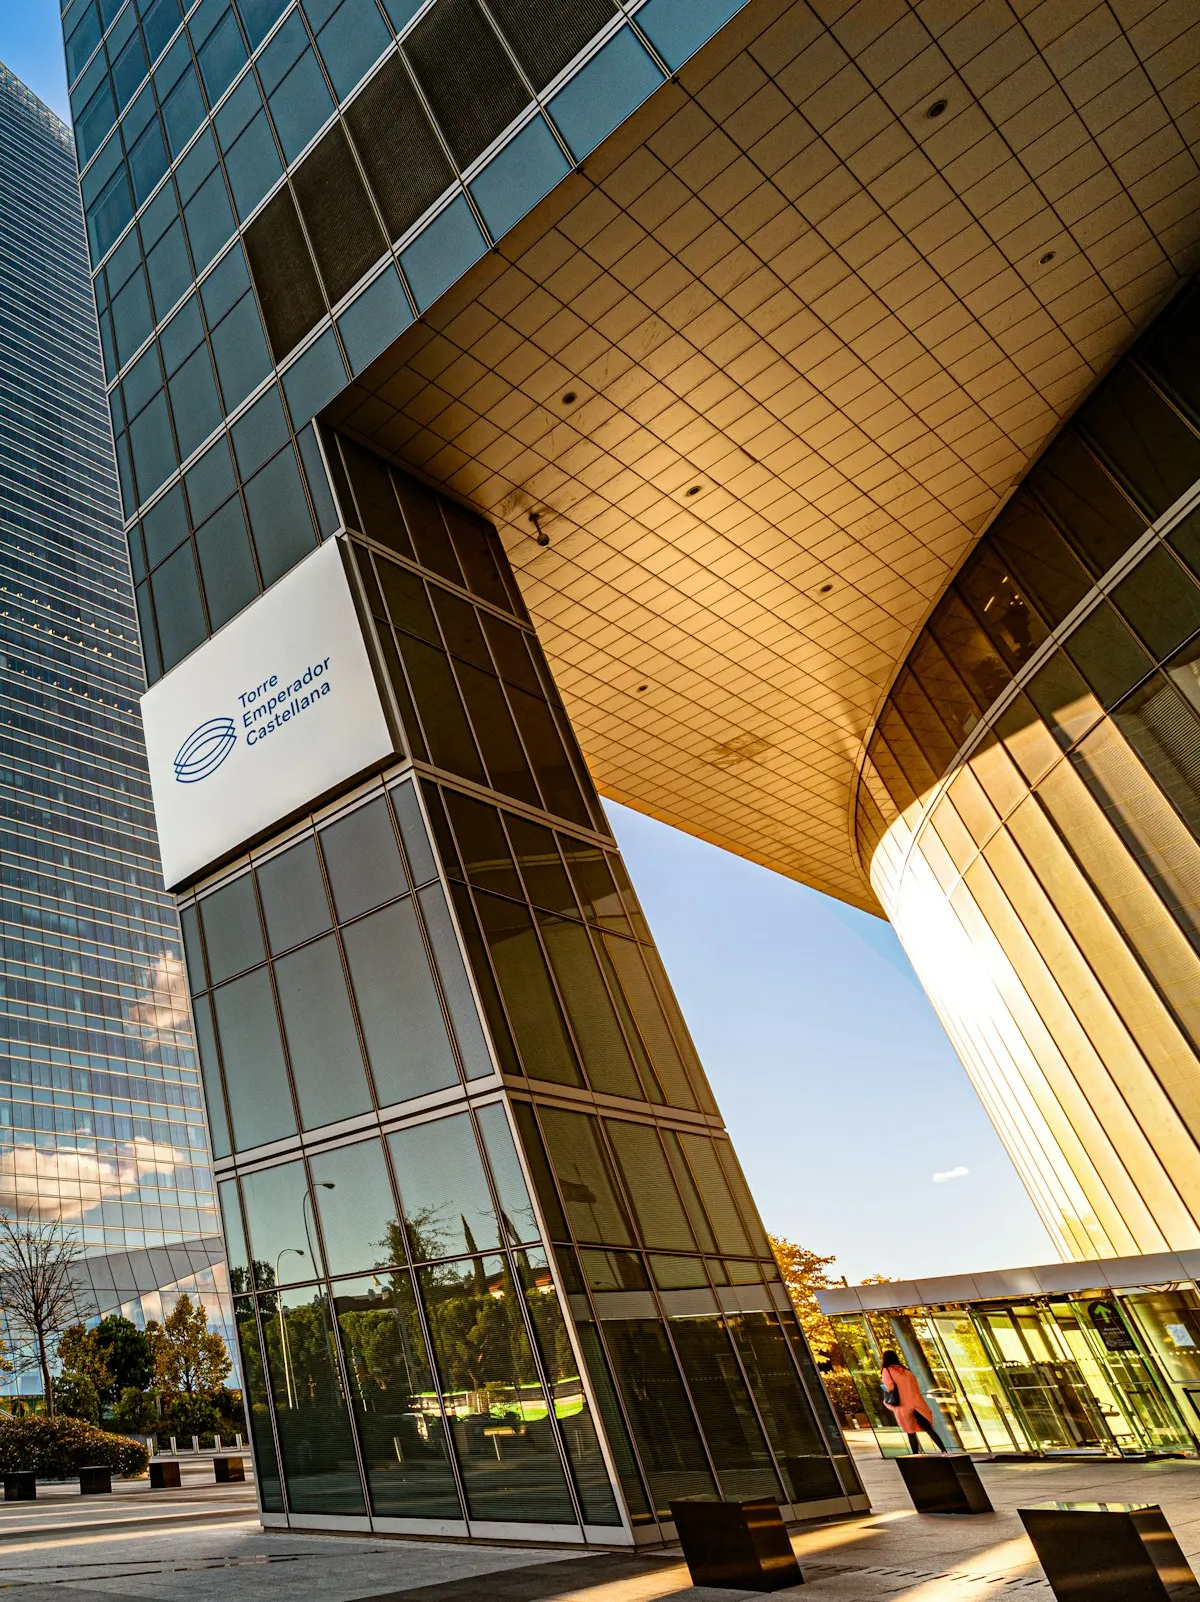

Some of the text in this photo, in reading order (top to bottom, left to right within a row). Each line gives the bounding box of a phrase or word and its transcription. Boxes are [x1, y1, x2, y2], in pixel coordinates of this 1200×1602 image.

[238, 675, 278, 708] Torre
[242, 657, 331, 728] Emperador
[246, 682, 331, 746] Castellana
